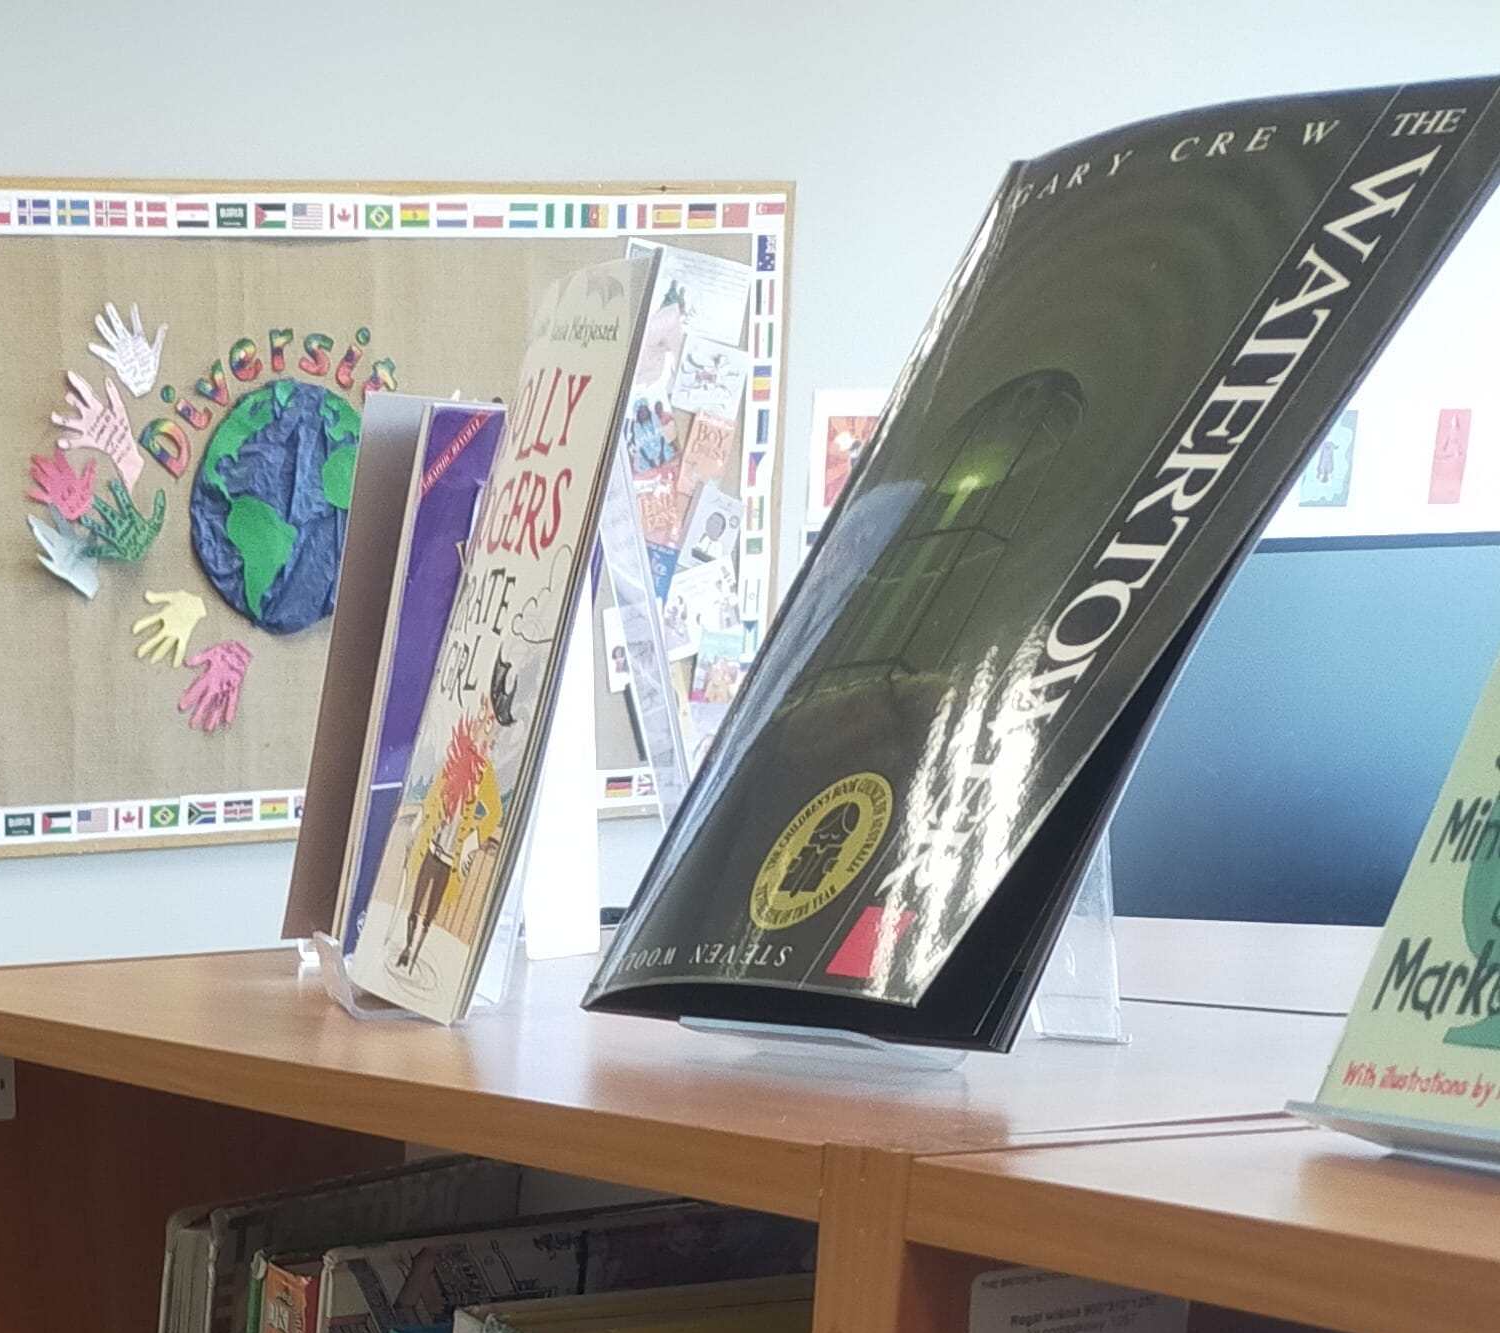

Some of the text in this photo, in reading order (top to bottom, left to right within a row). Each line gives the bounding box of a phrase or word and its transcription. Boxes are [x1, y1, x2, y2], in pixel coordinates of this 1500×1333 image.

[1170, 119, 1341, 163] CREW
[1389, 107, 1468, 139] THE
[688, 943, 794, 968] STEVEN
[1342, 1060, 1494, 1107] With illustrations by
